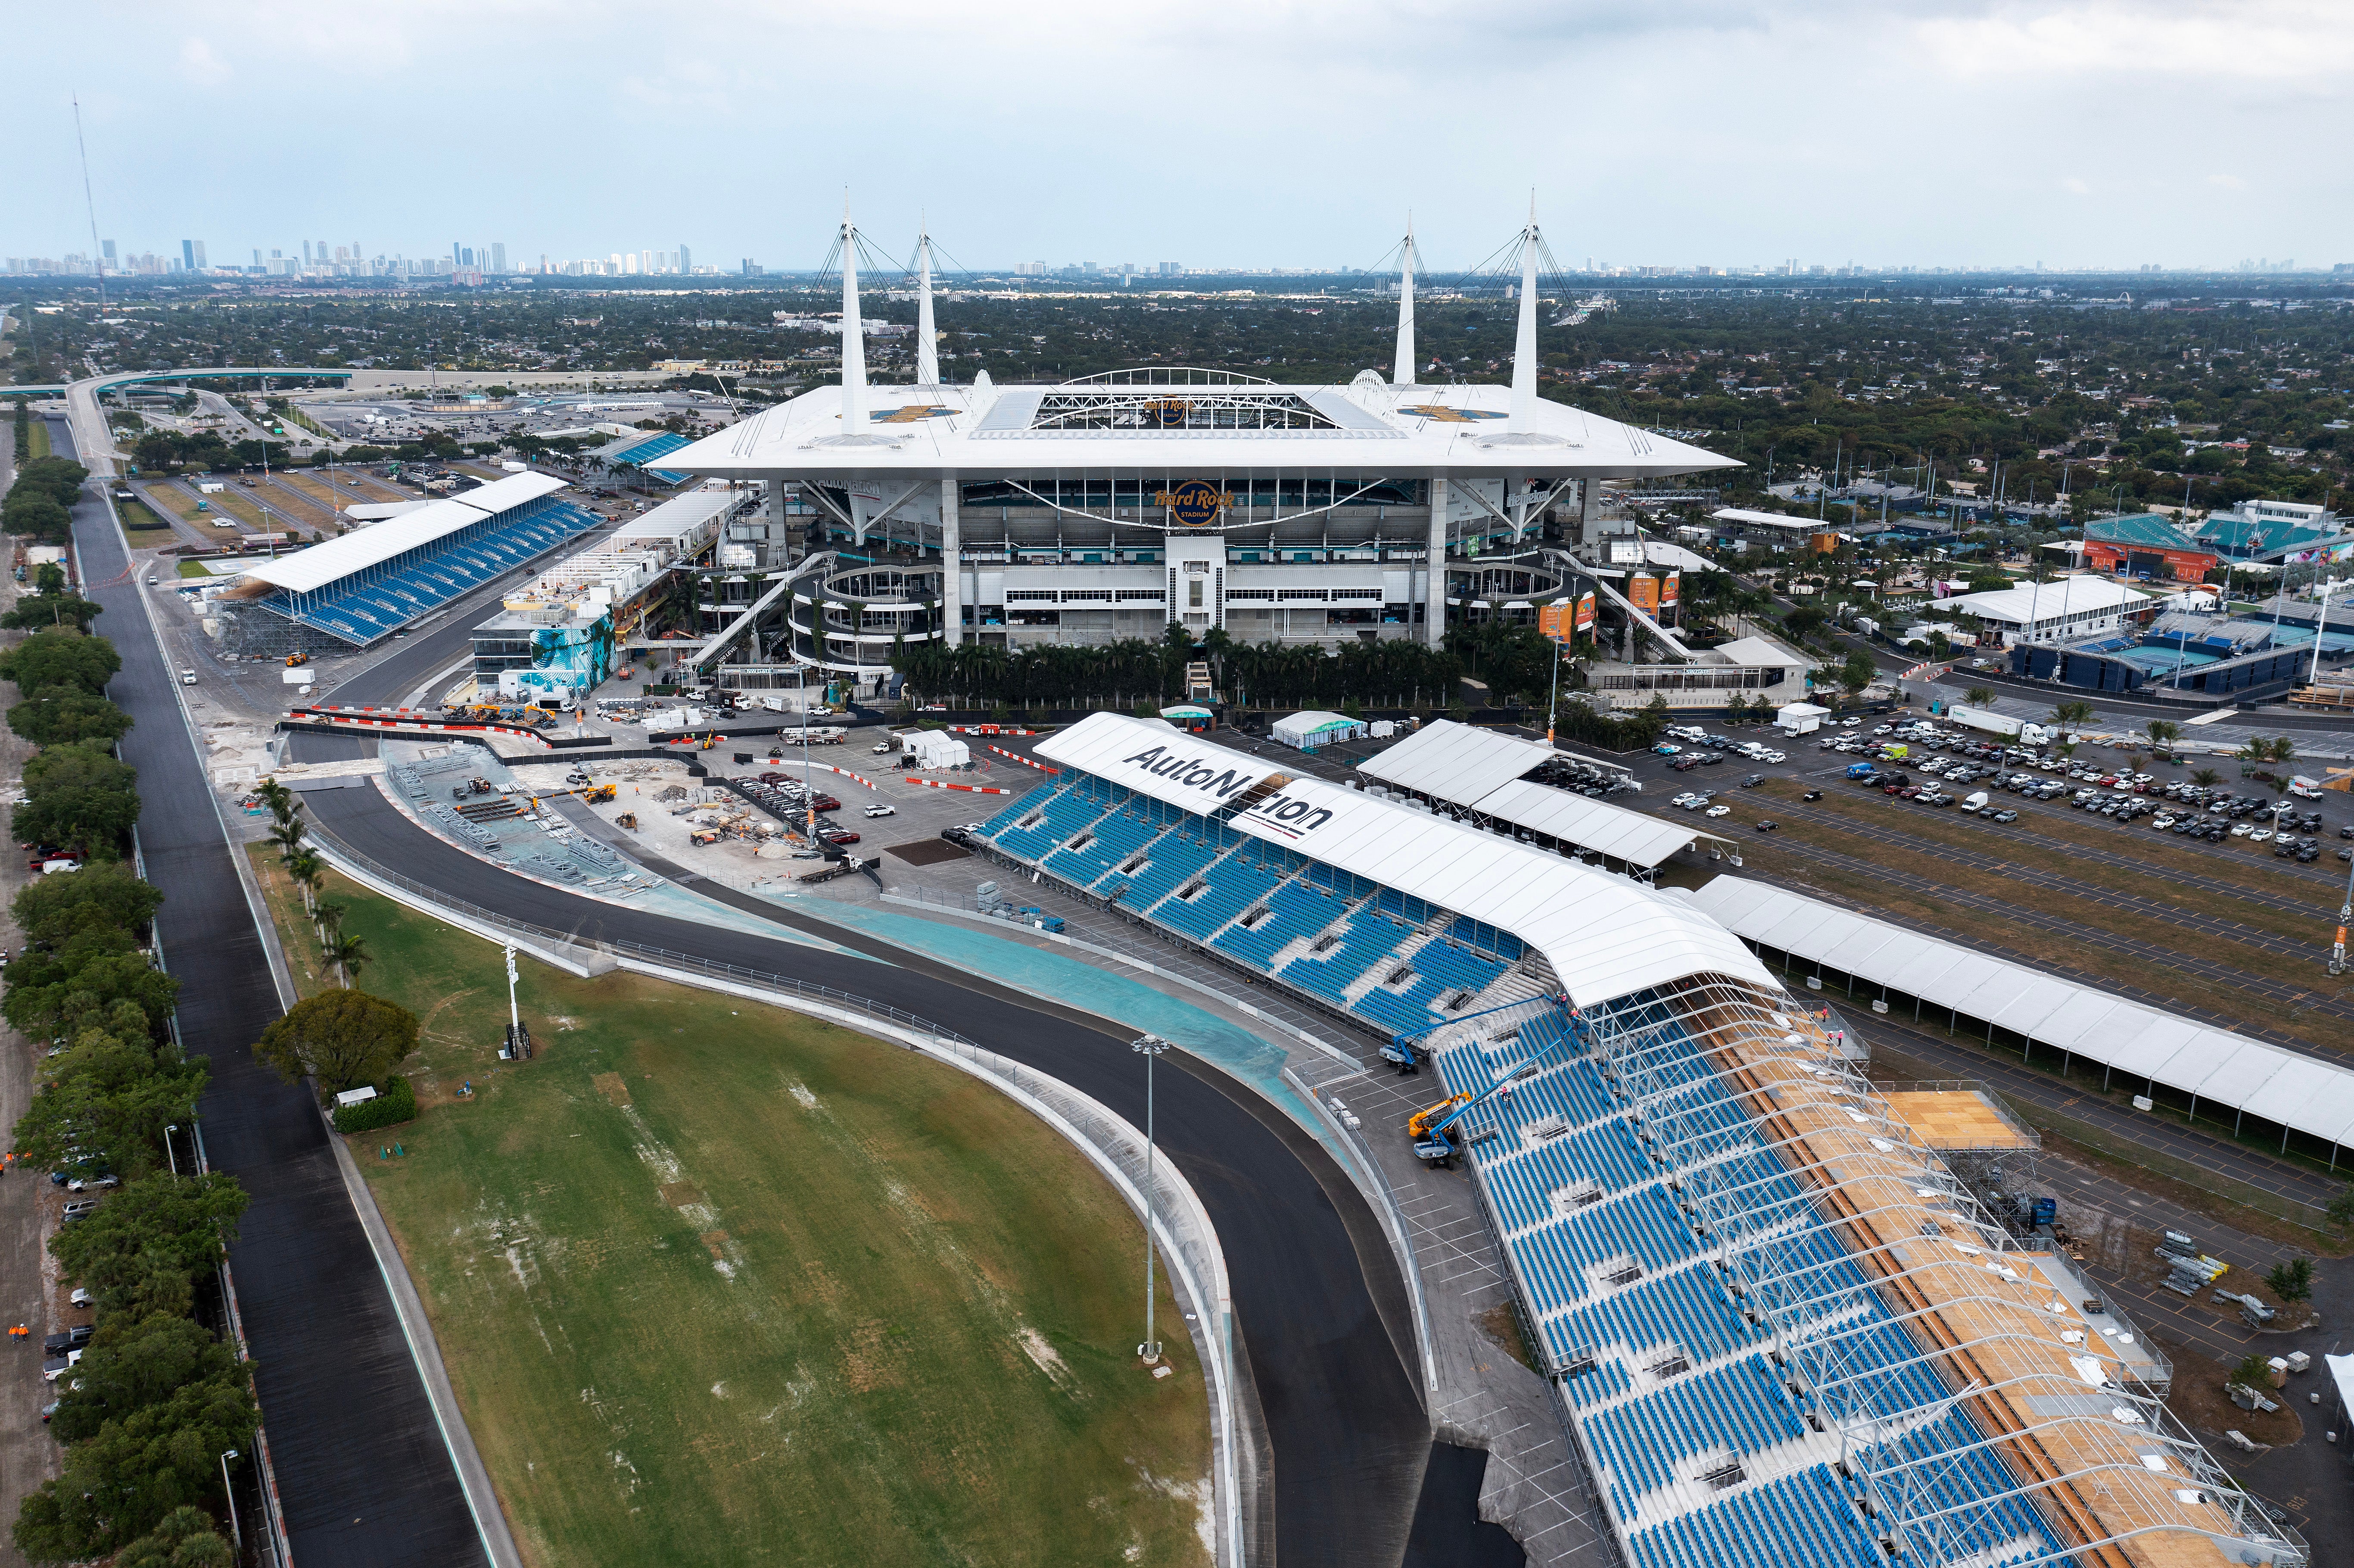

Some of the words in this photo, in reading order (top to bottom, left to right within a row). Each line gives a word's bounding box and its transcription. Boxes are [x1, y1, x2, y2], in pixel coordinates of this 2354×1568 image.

[1144, 400, 1169, 410] Hard
[1170, 400, 1194, 412] Rock
[1154, 490, 1196, 506] Hard
[1196, 490, 1235, 509] Rock
[1506, 490, 1551, 507] Heineken
[717, 655, 727, 664] 300
[726, 645, 738, 657] LEVEL
[1653, 646, 1666, 659] LEVEL
[1322, 722, 1346, 730] CREDENTIALS
